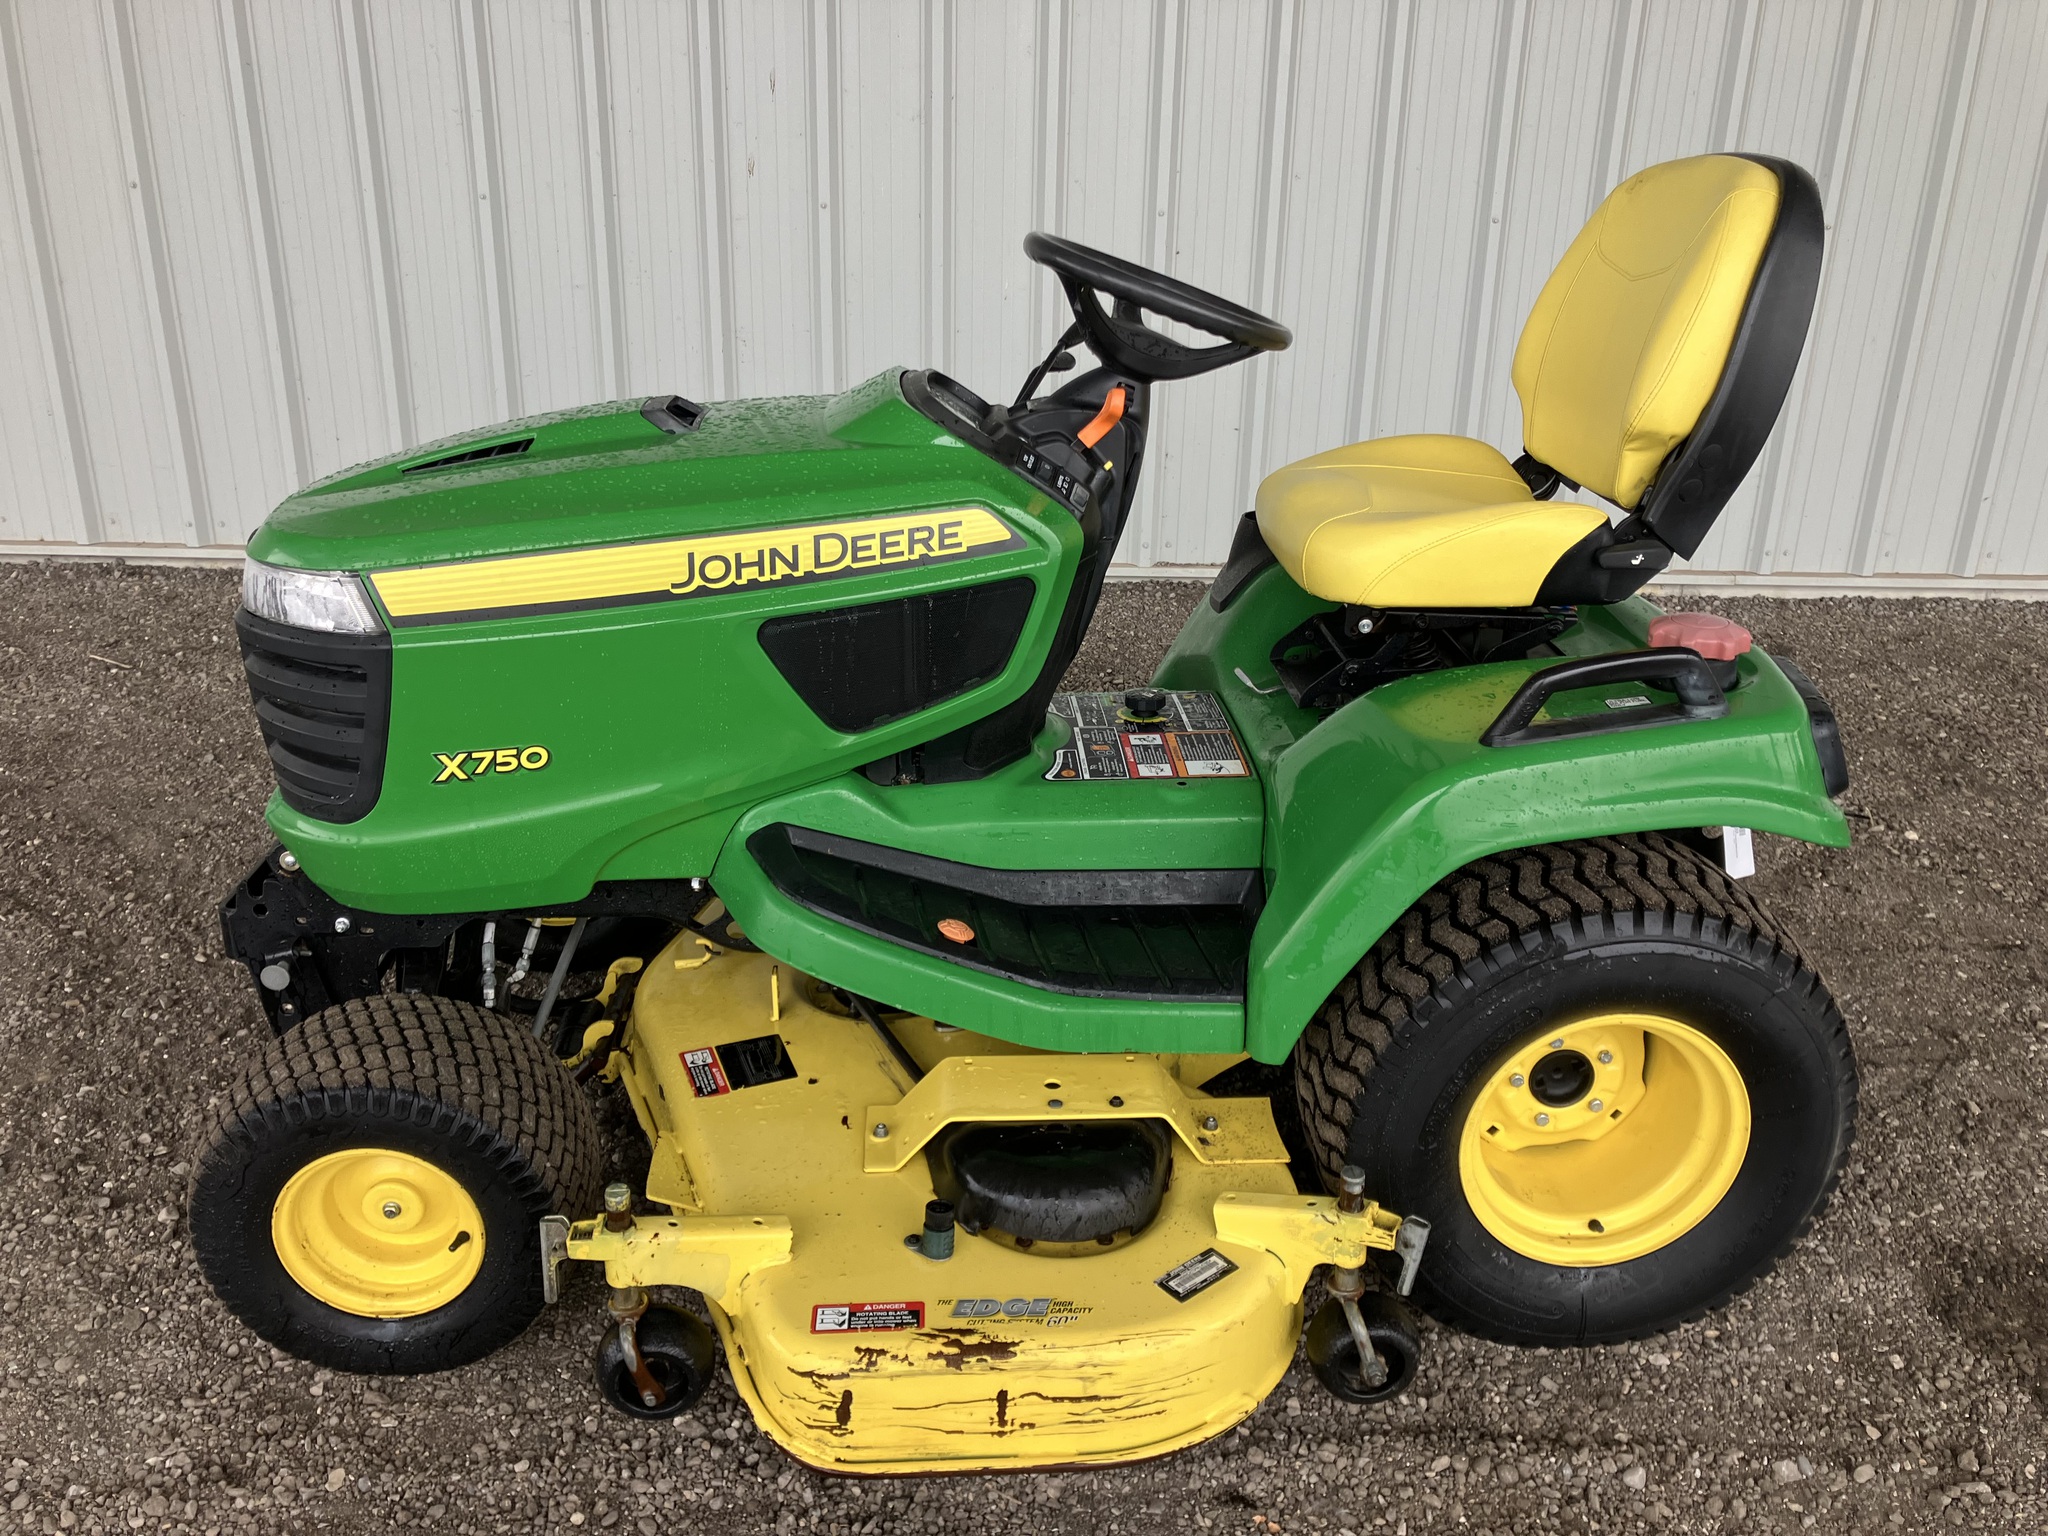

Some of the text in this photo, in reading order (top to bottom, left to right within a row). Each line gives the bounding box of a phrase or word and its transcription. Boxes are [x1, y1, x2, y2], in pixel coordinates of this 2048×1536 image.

[669, 520, 965, 592] JOHN DEERE
[431, 745, 551, 785] X750
[951, 1298, 1052, 1318] EDGE
